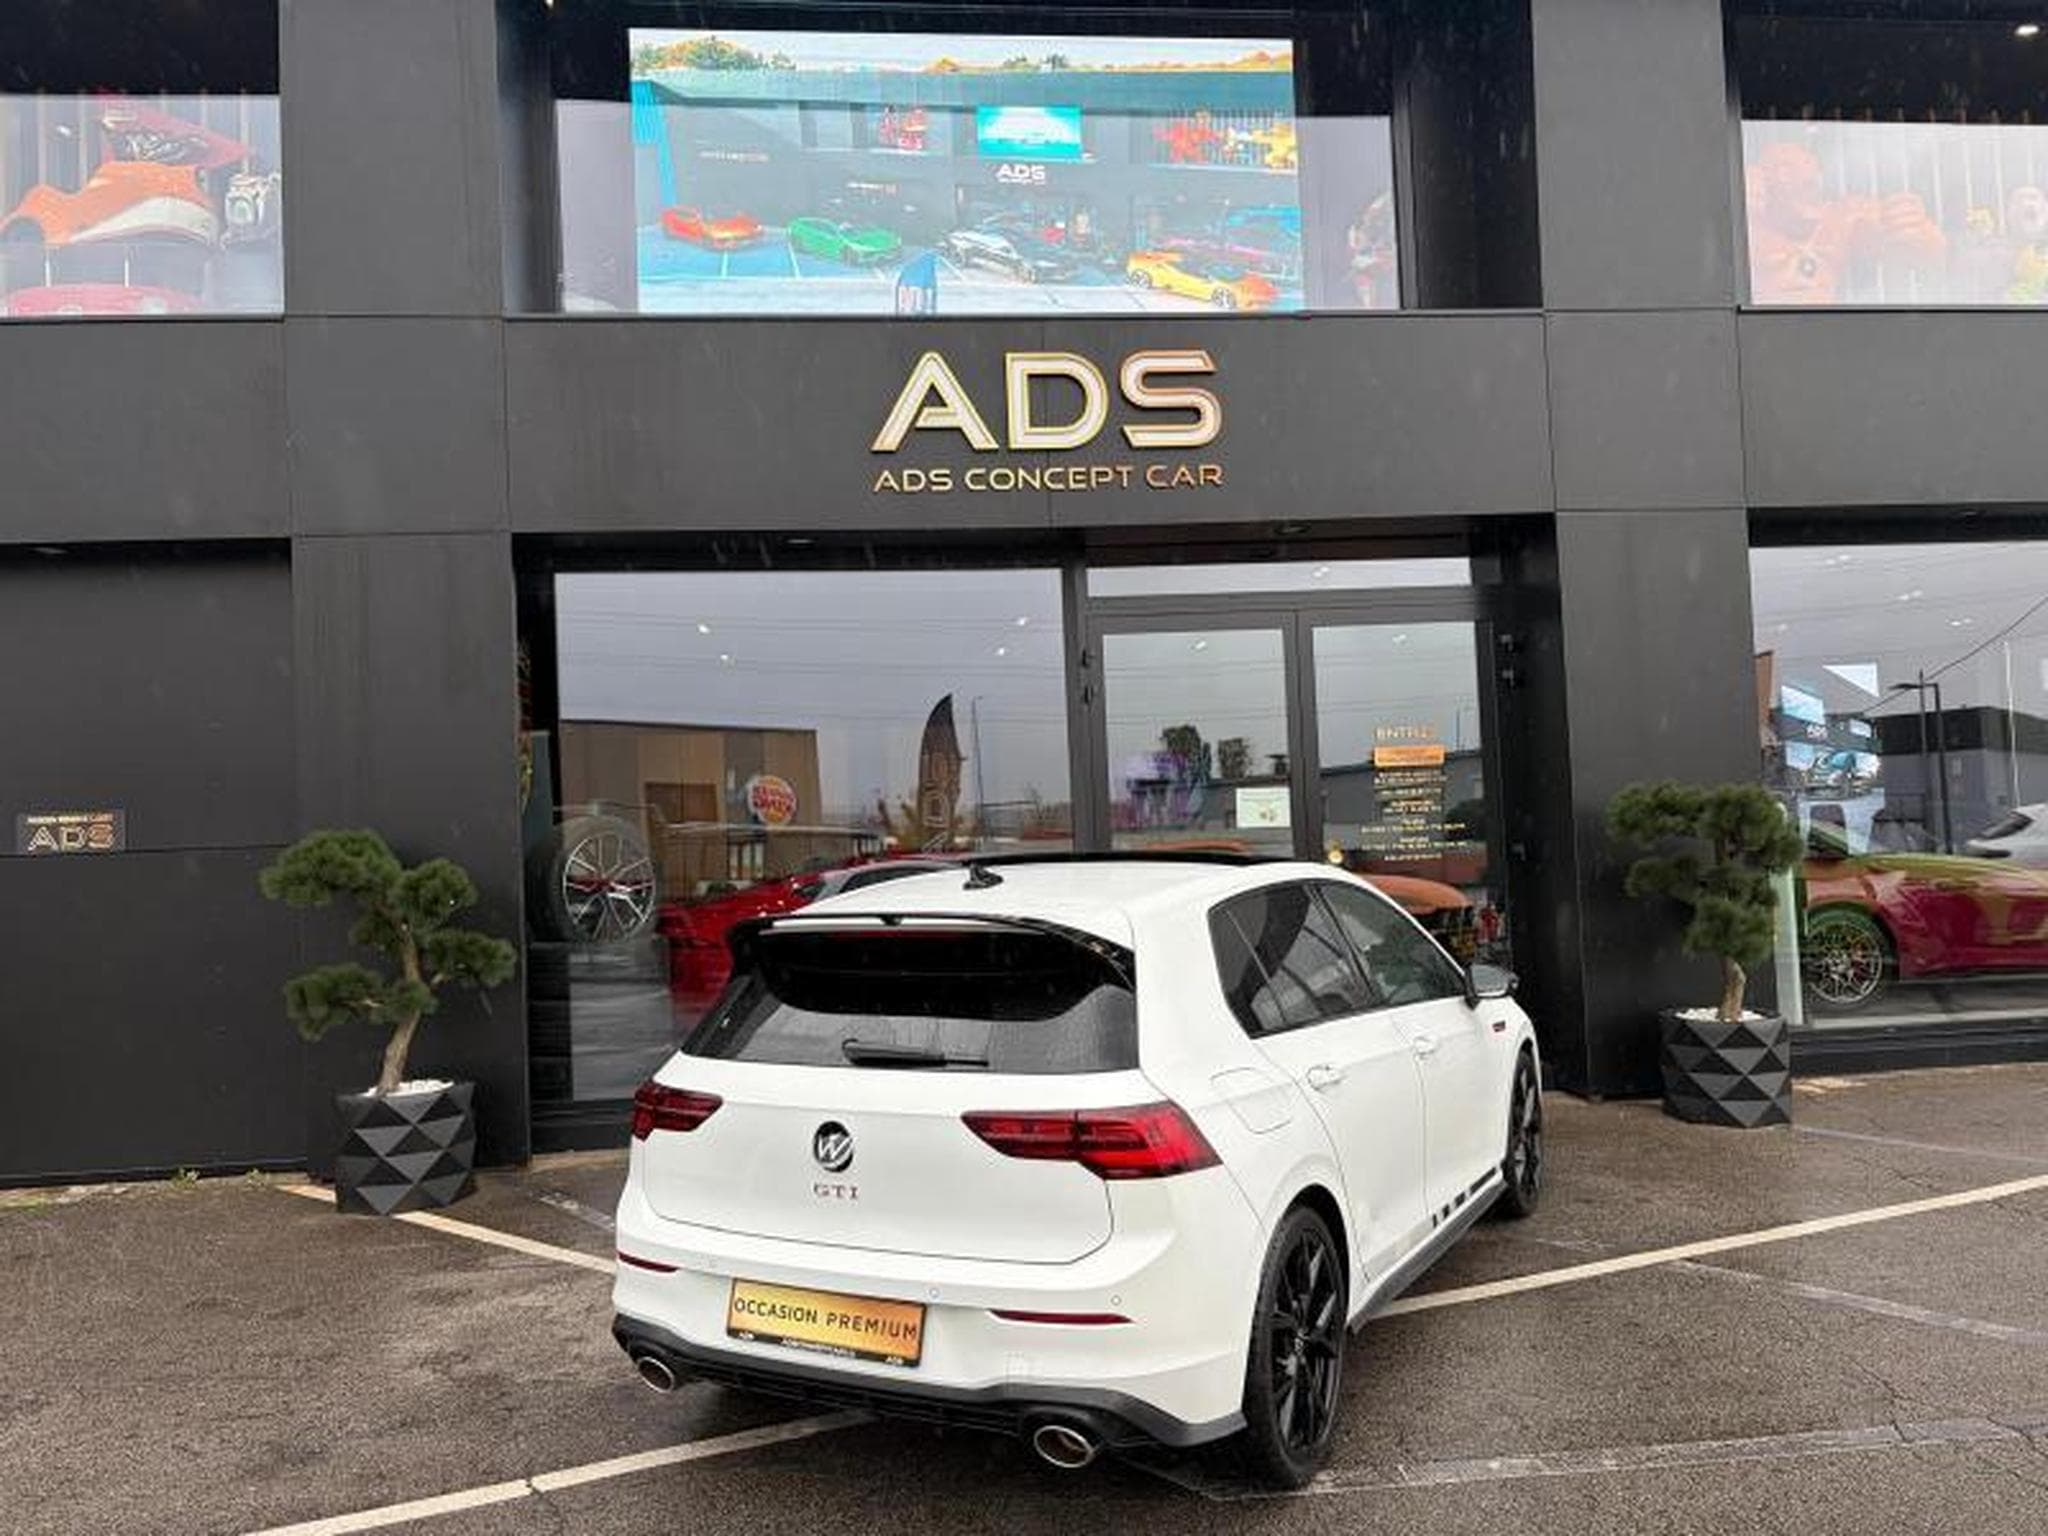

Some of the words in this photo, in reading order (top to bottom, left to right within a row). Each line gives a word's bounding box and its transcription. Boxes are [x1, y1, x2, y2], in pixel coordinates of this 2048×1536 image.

[871, 350, 1223, 452] ADS
[873, 468, 953, 492] ADS
[964, 465, 1133, 490] CONCEPT
[1145, 463, 1224, 487] CAR
[813, 1183, 859, 1201] GTI
[733, 1296, 819, 1325] OCCASION
[825, 1312, 918, 1339] PREMIUM
